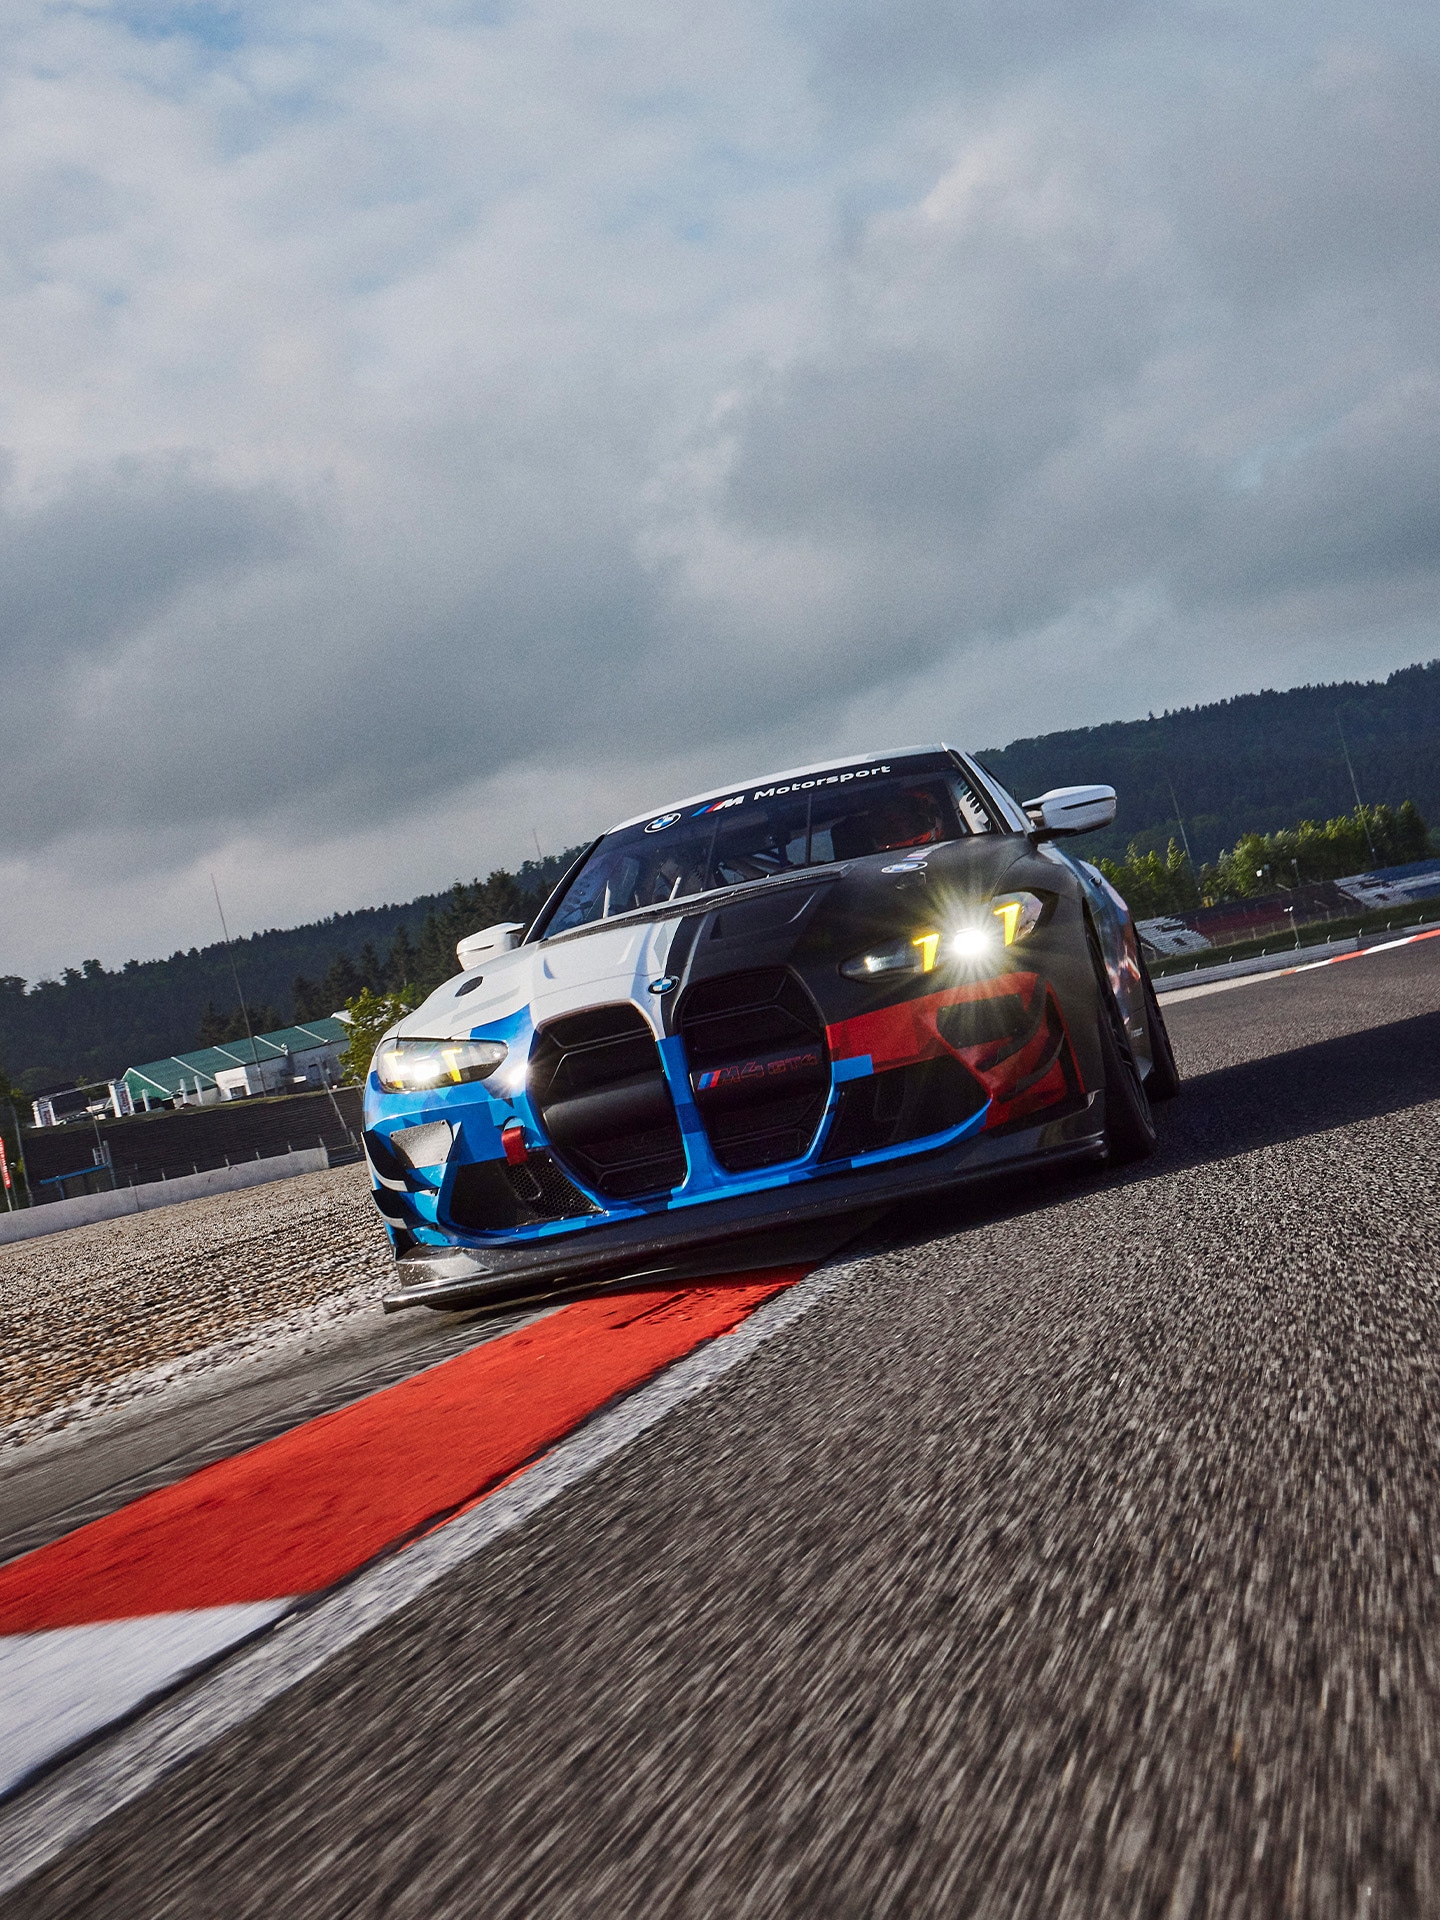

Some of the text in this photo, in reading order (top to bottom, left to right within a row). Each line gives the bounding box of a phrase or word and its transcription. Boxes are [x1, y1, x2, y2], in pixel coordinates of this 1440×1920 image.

[712, 765, 891, 812] M Motorsport
[717, 1054, 818, 1086] M4 GT4
